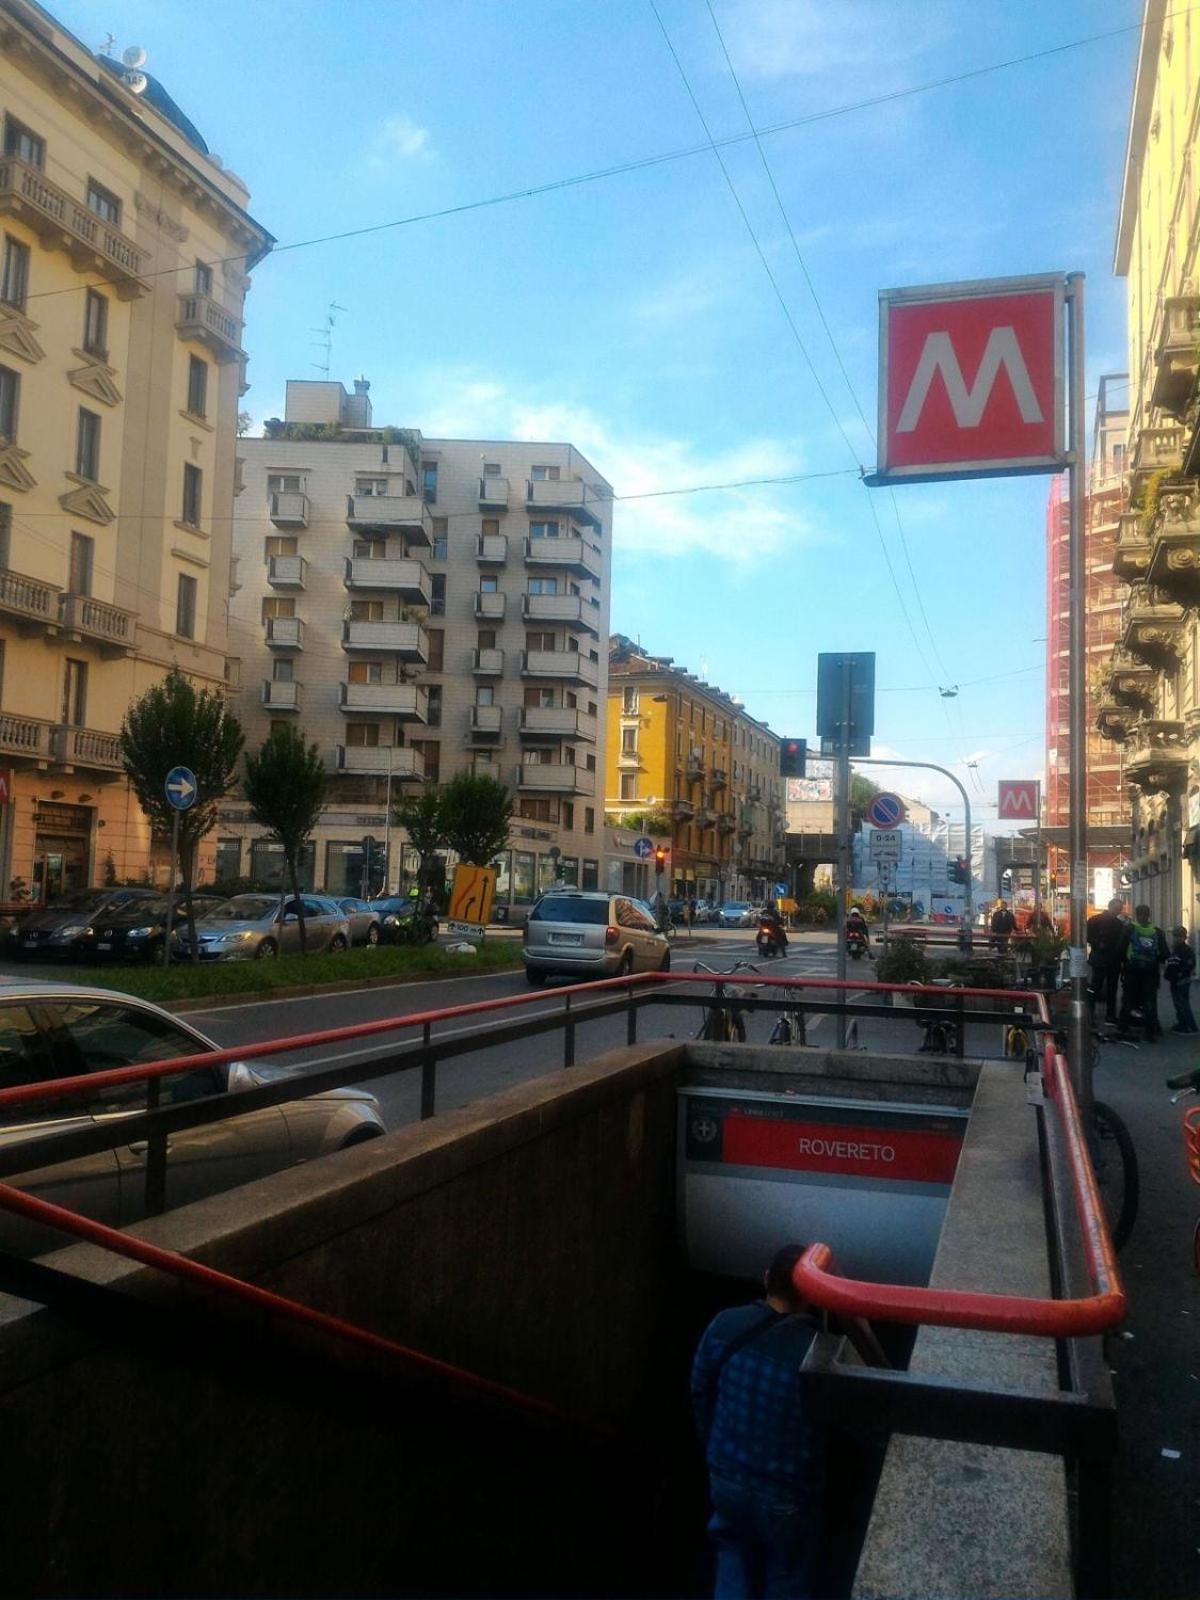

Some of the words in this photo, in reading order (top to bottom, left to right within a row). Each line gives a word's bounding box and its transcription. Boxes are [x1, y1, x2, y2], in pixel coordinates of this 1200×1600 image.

[896, 326, 1044, 432] M
[1003, 790, 1032, 810] M
[799, 1138, 896, 1162] ROVERETO
